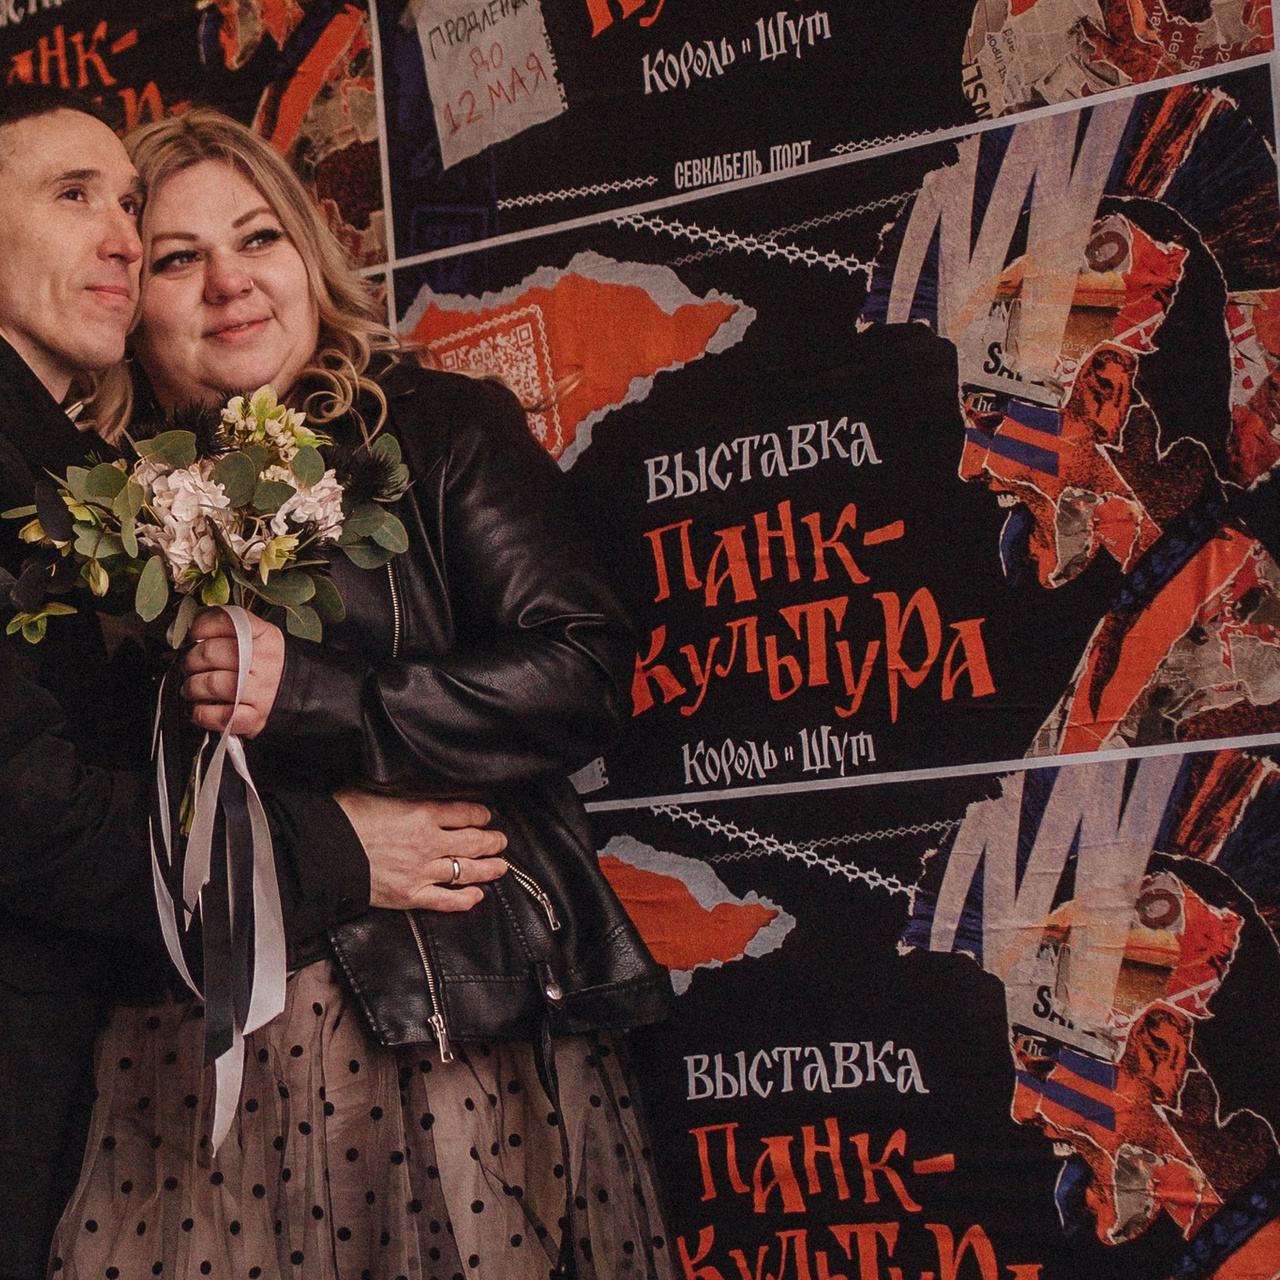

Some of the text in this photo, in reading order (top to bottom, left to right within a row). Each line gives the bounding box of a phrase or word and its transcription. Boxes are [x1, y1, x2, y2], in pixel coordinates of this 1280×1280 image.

[488, 52, 549, 111] МАЯ
[675, 139, 812, 189] СЕВКАБЕЛЬ ПОРТ
[643, 500, 906, 607] ПАНК-
[688, 1117, 955, 1214] ПАНК-
